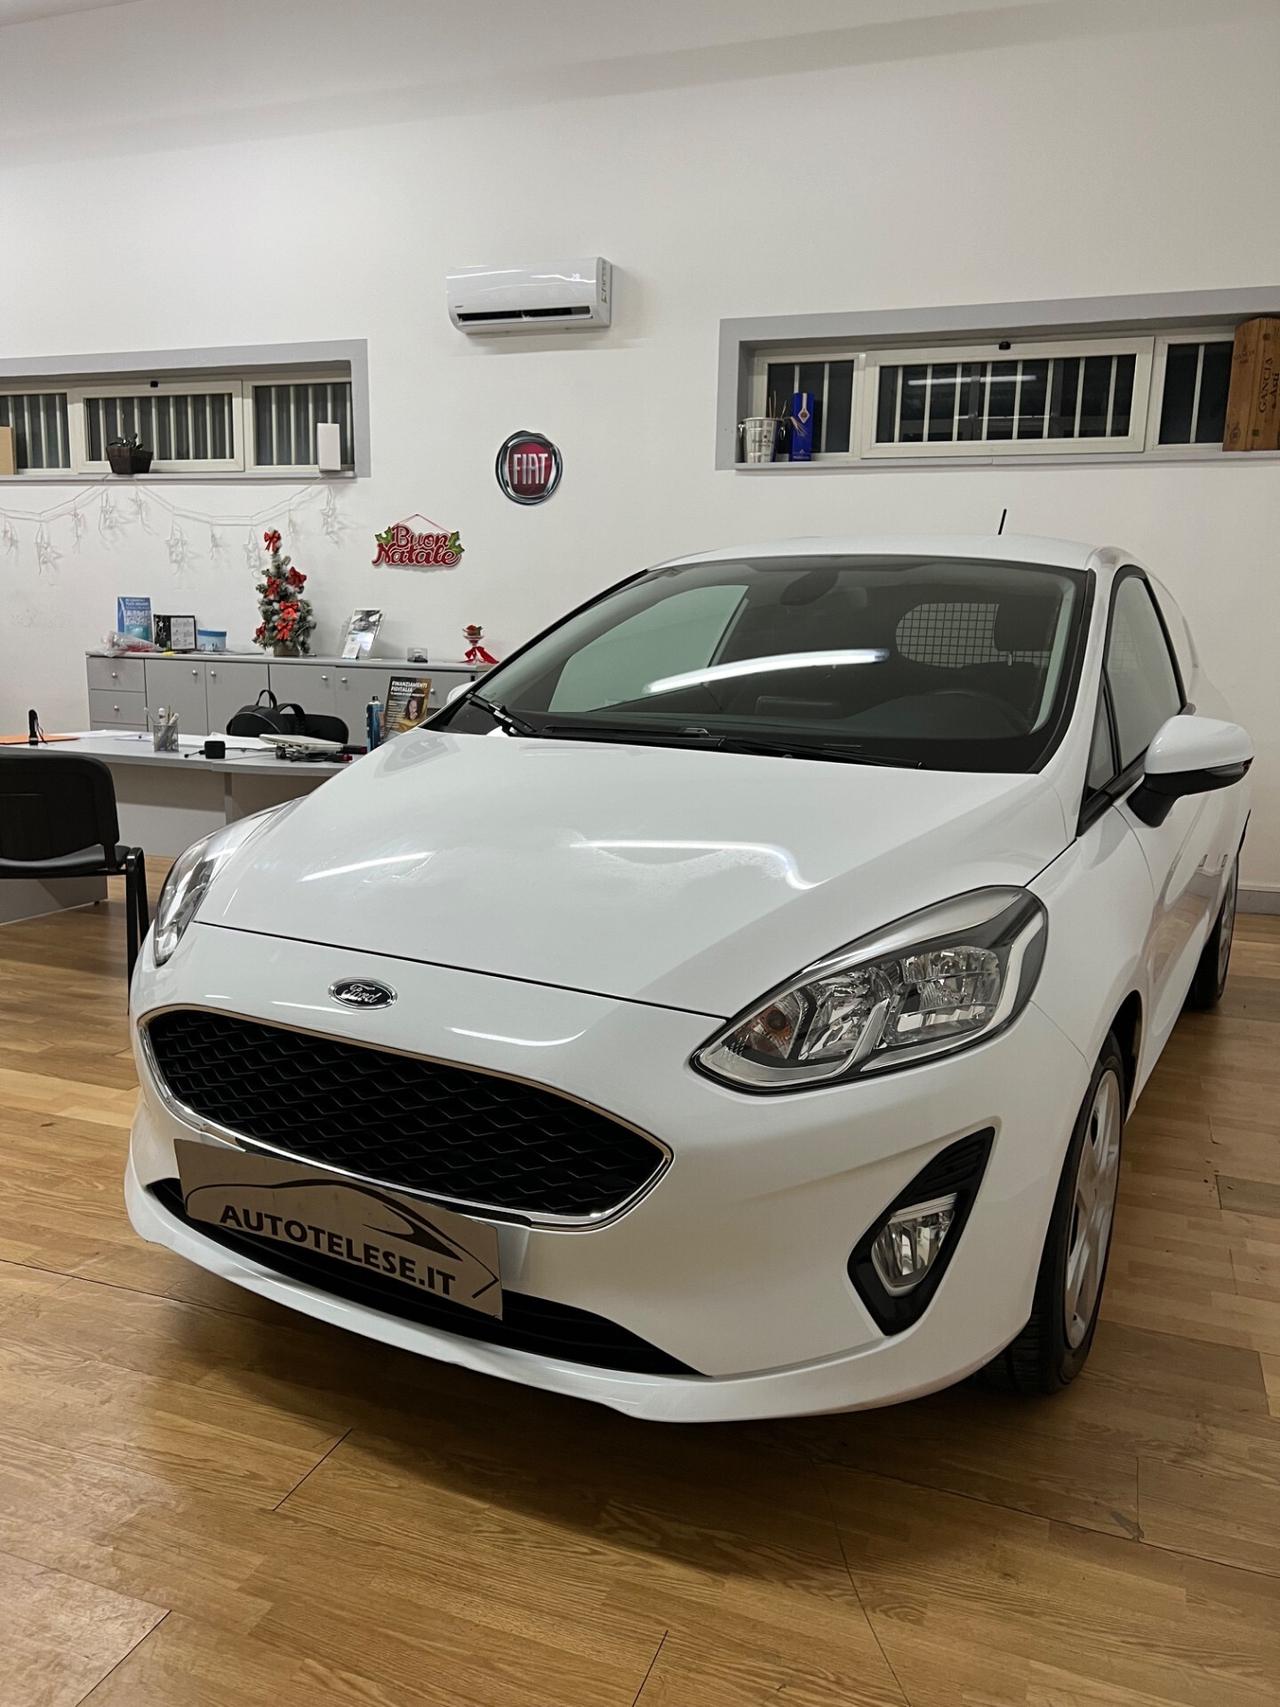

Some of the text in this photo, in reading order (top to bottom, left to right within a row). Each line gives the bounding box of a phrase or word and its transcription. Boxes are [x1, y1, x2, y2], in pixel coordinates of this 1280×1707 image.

[1258, 357, 1273, 413] GANCIA
[513, 453, 548, 485] FIAT
[391, 524, 449, 549] Buon
[372, 542, 460, 567] Natale
[340, 984, 382, 1003] Ford
[219, 1204, 456, 1295] AUTOTELESE.IT
